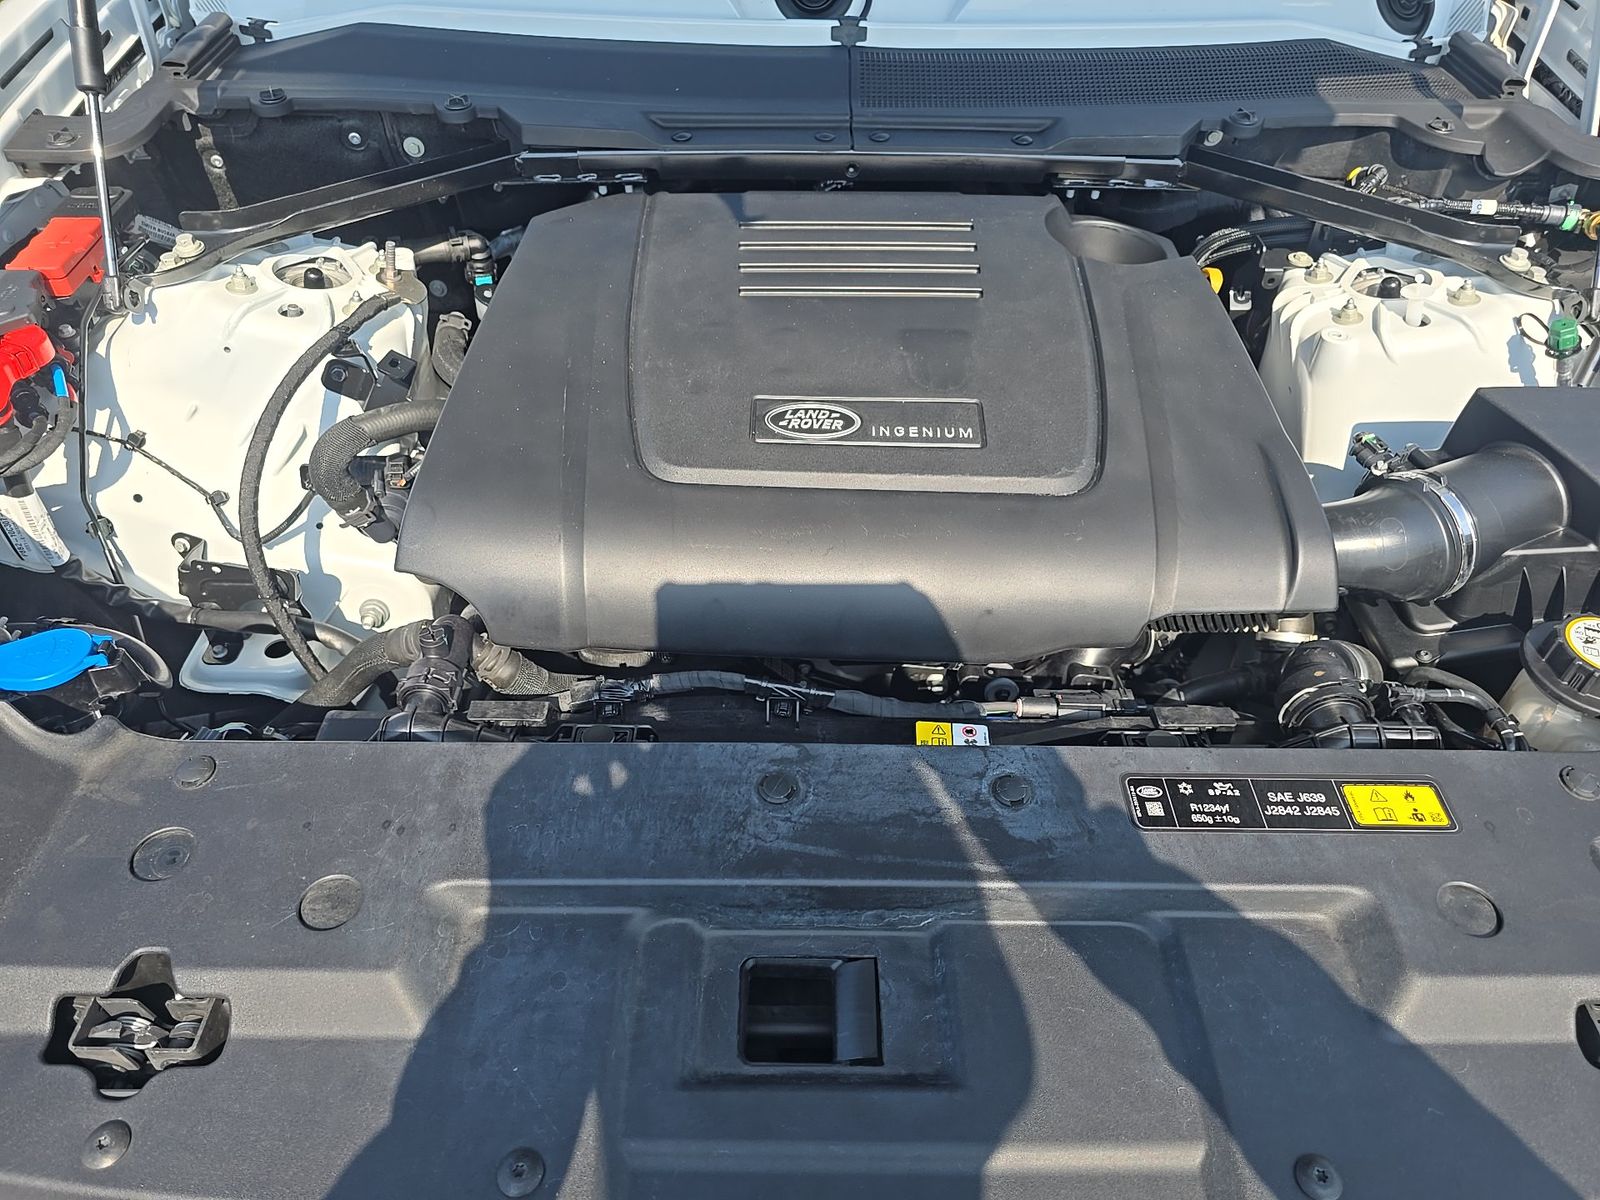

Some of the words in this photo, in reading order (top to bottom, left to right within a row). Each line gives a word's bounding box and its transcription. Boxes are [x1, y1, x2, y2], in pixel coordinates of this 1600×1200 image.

[785, 409, 829, 420] LAND
[788, 418, 844, 430] ROVER
[871, 425, 974, 439] INGENIUM
[1266, 791, 1296, 803] SAE
[1296, 792, 1326, 803] J639
[1264, 804, 1302, 816] J2842
[1303, 805, 1341, 817] J2845
